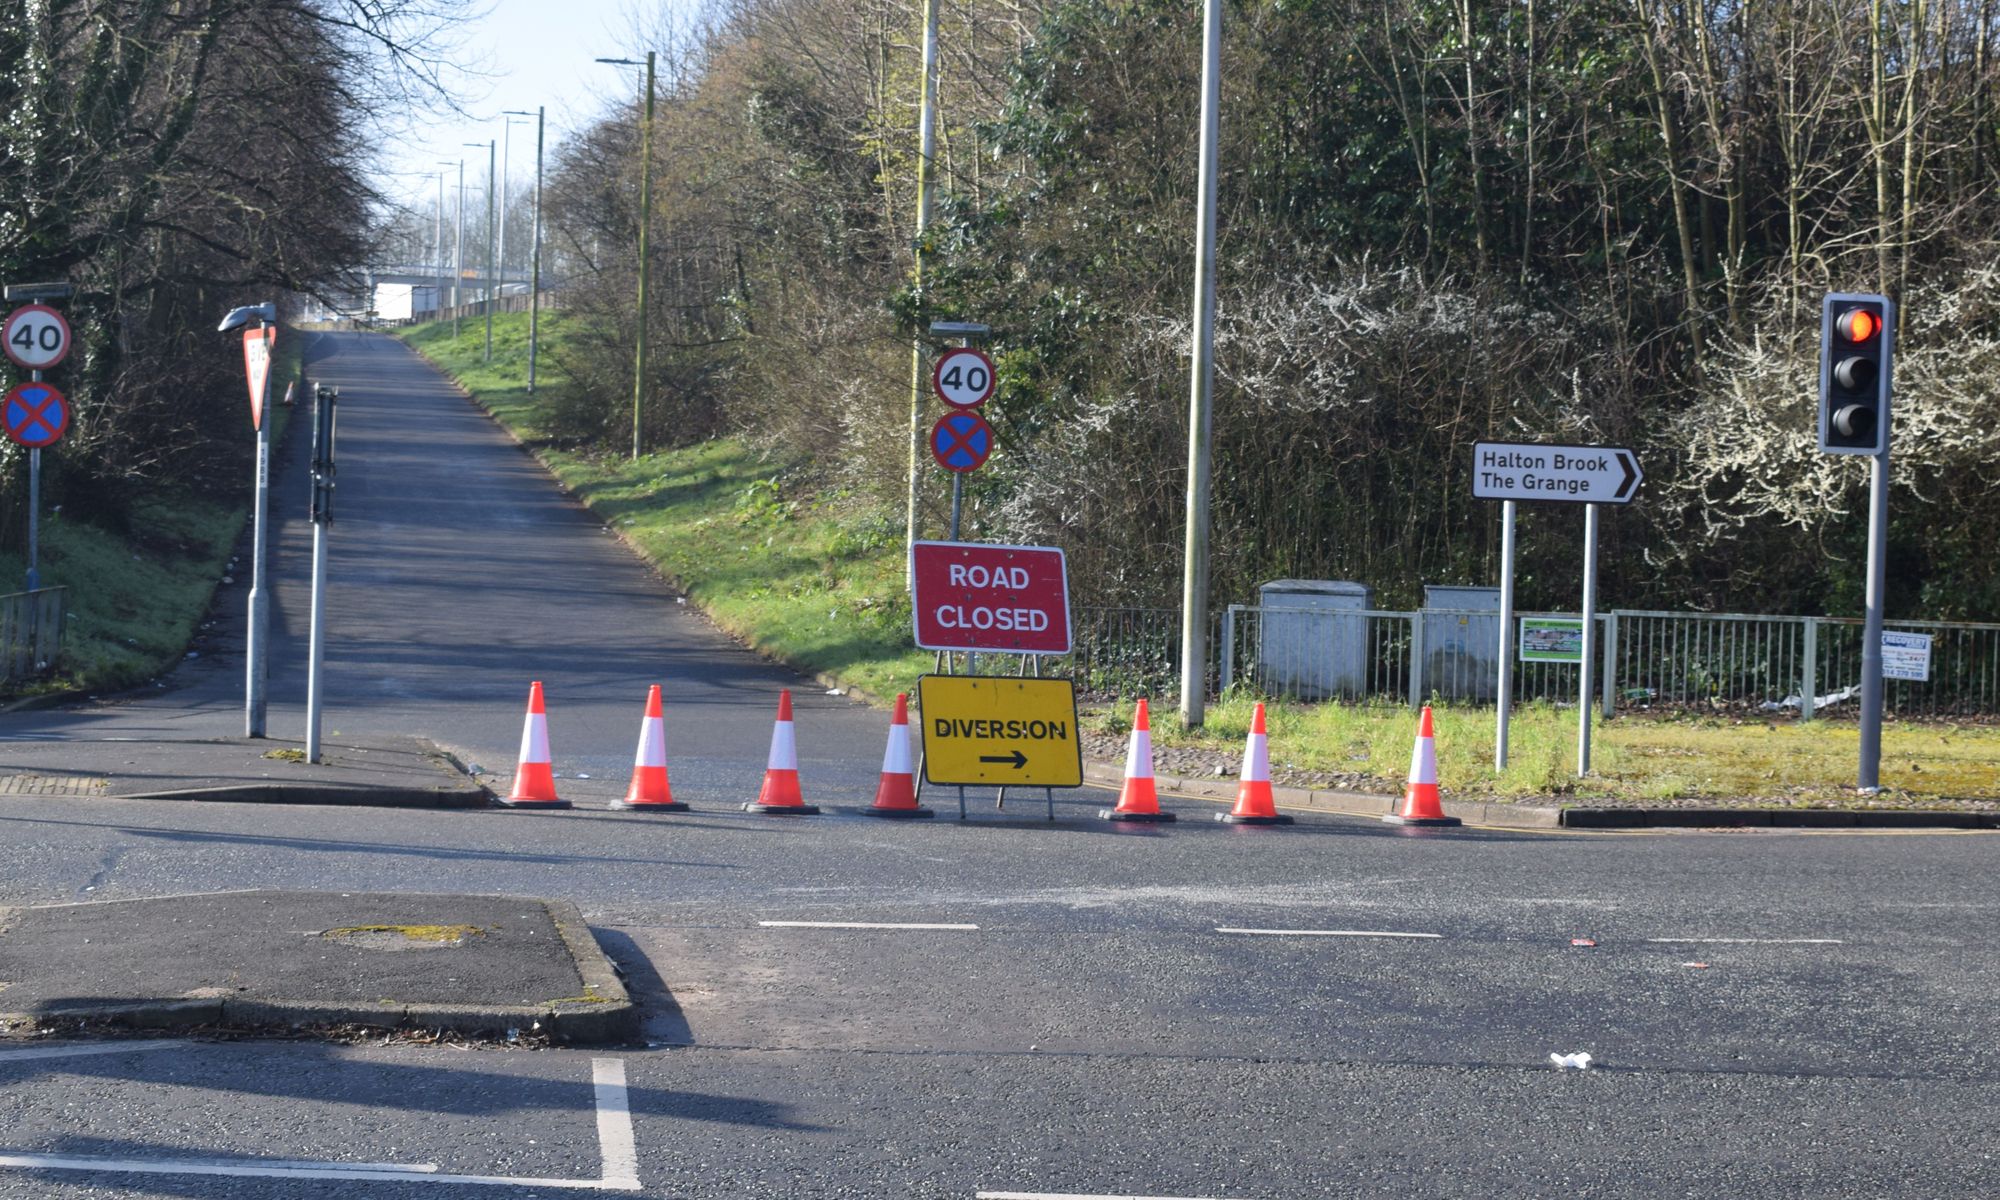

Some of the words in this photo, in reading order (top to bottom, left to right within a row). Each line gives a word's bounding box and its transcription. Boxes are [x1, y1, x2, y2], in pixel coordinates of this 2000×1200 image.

[12, 324, 61, 352] 40
[942, 366, 988, 392] 40
[1483, 451, 1545, 469] Halton
[1553, 454, 1608, 472] Brook
[1481, 472, 1514, 489] The
[1522, 473, 1590, 494] Grange
[950, 564, 1029, 590] ROAD
[936, 605, 1048, 632] CLOSED
[935, 719, 1067, 740] DIVERSION
